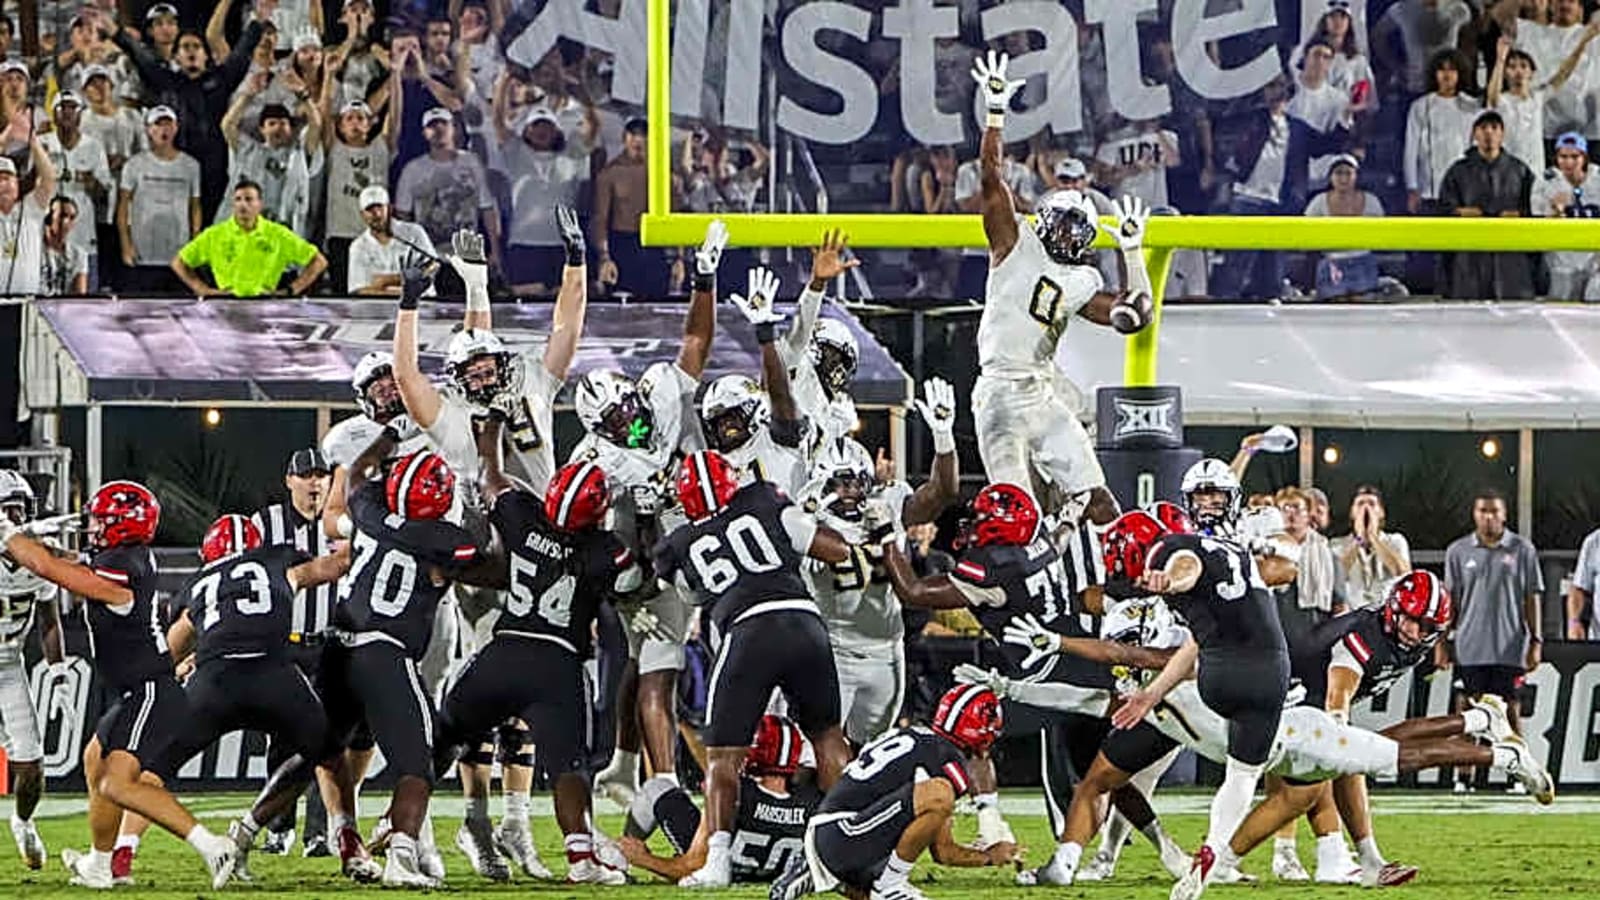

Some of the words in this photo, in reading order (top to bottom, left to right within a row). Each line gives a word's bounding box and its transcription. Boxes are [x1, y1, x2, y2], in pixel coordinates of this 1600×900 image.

[505, 0, 1283, 145] Allstate
[1029, 275, 1063, 327] 0
[336, 528, 417, 617] 70
[525, 531, 574, 560] GRAYS
[689, 514, 784, 595] 60
[1201, 538, 1268, 601] 3
[191, 561, 272, 631] 73
[507, 551, 577, 628] 54
[842, 732, 916, 780] 9
